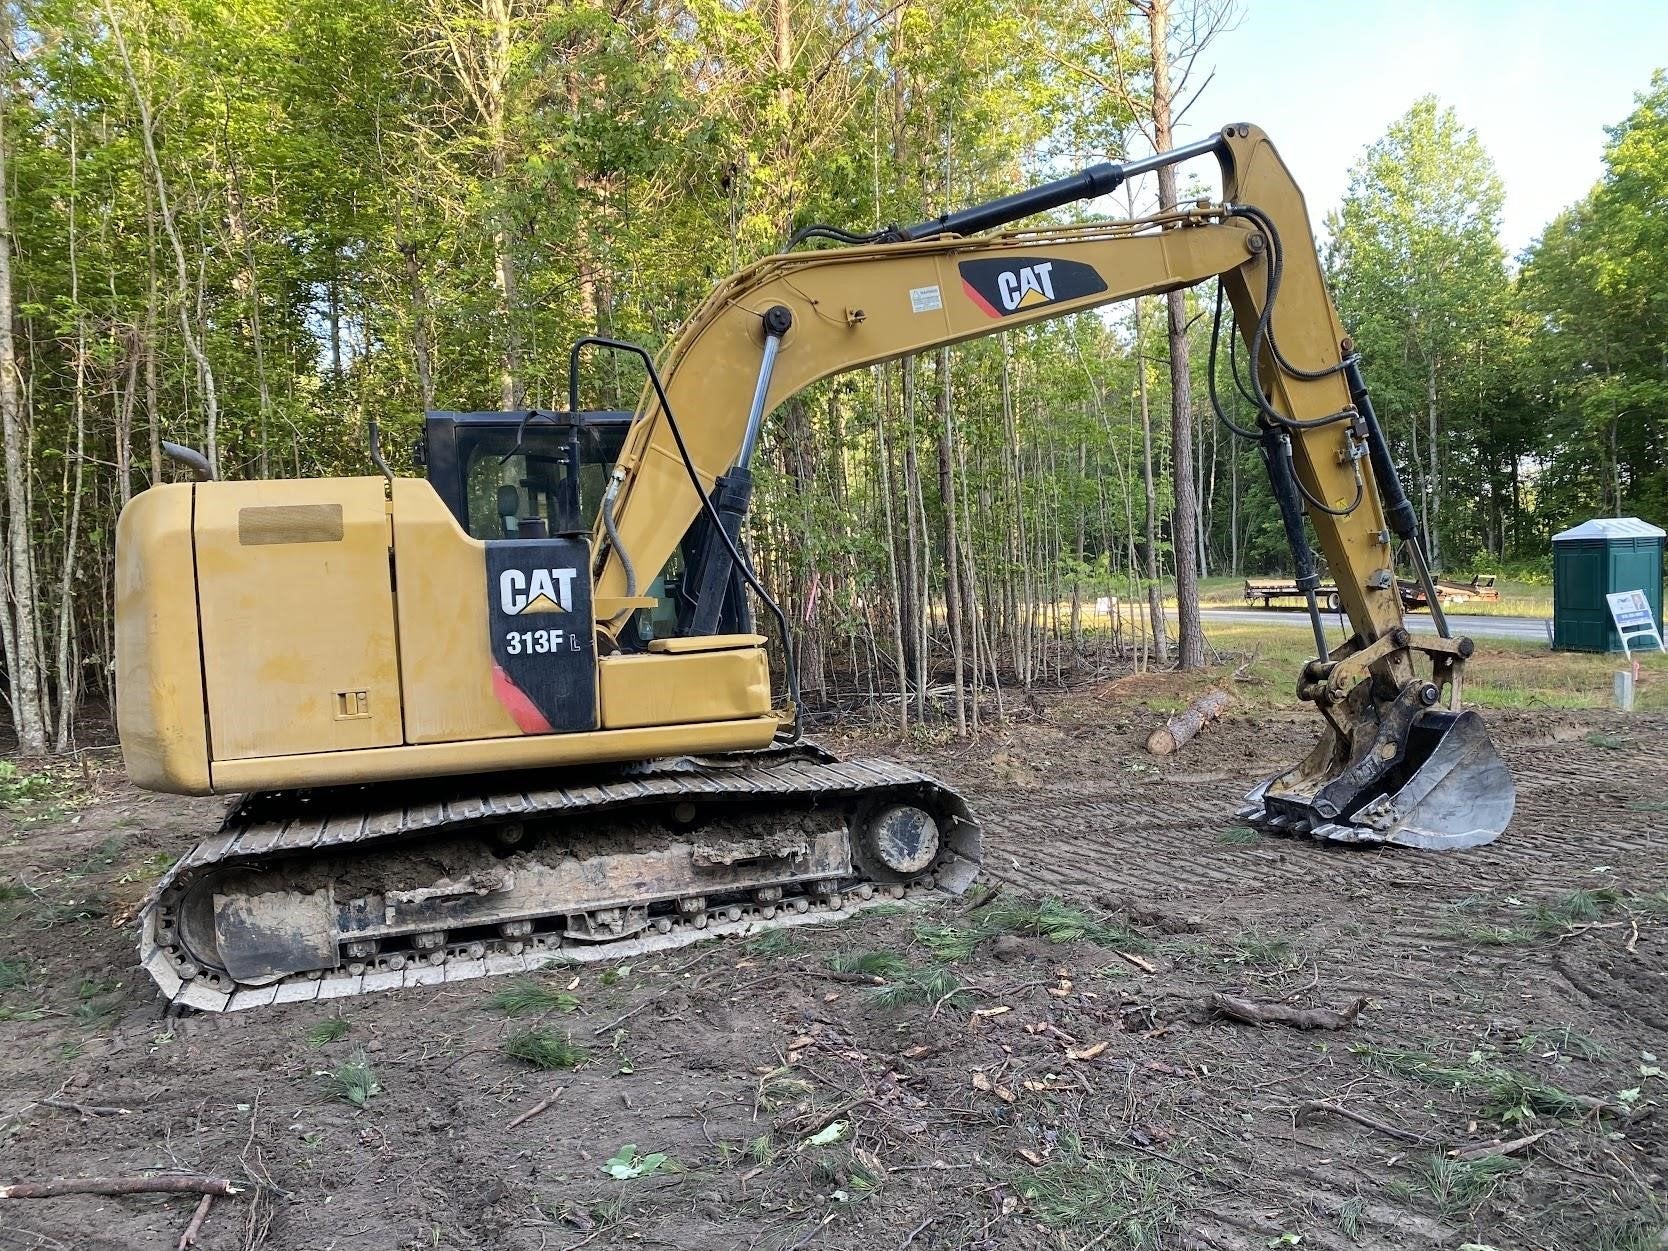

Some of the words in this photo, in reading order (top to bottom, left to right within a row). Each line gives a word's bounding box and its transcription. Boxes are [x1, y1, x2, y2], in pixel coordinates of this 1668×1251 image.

[998, 262, 1055, 310] CAT
[500, 568, 577, 615] CAT
[506, 630, 563, 654] 313F
[569, 634, 580, 651] L
